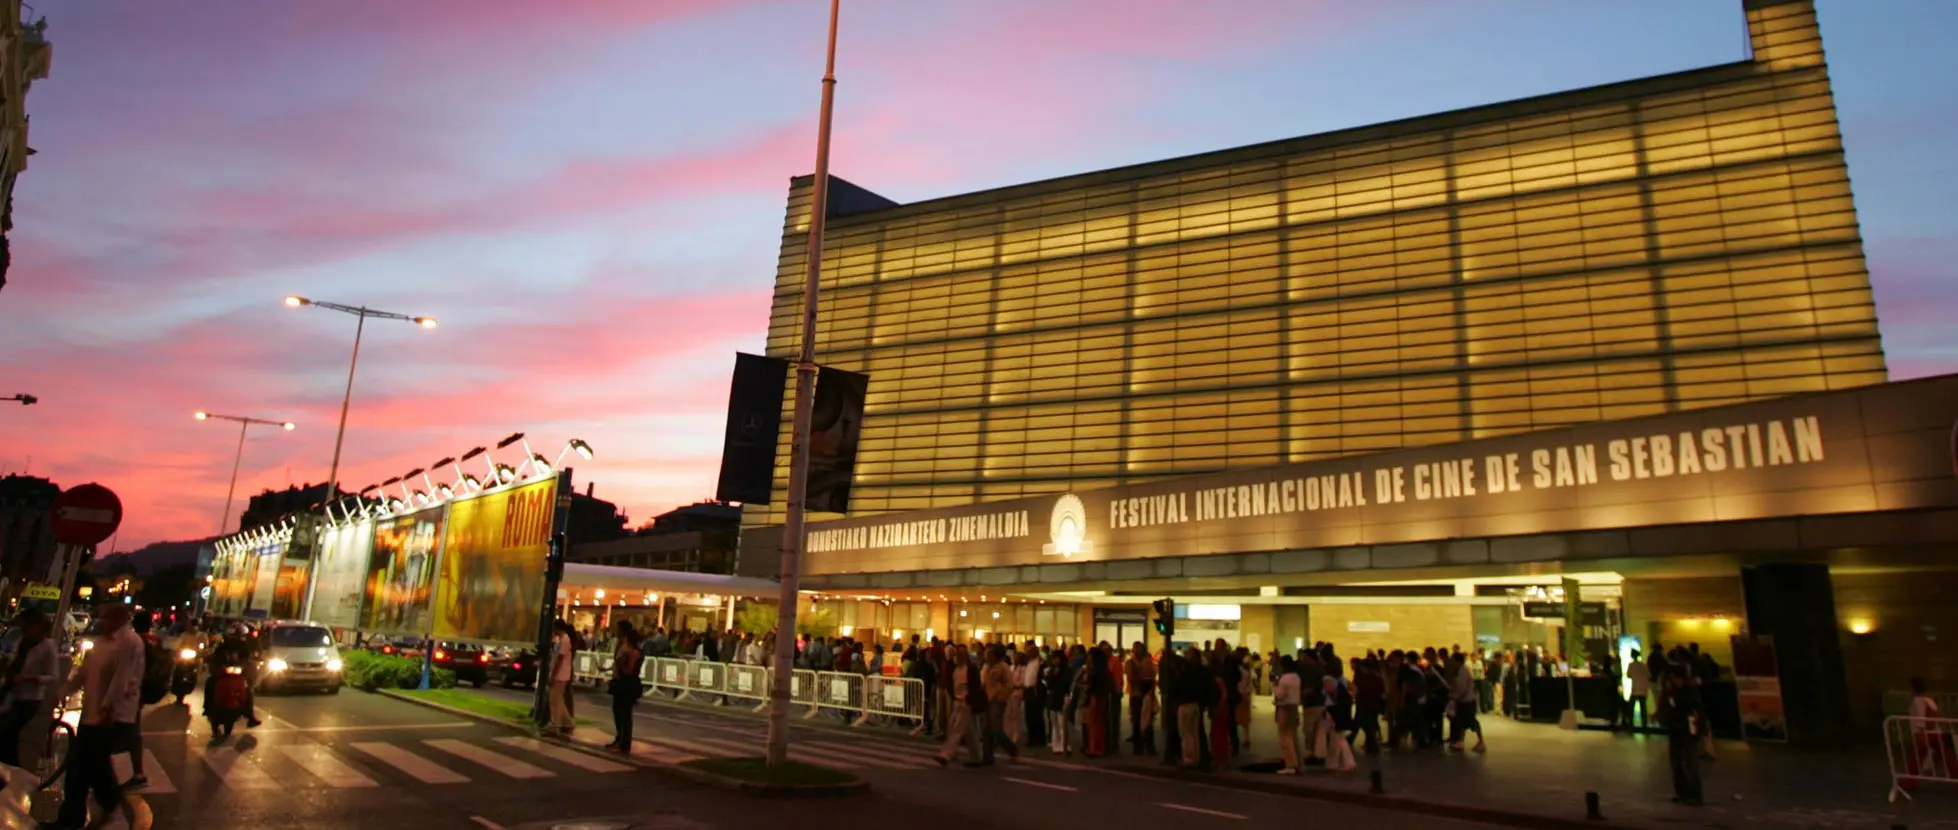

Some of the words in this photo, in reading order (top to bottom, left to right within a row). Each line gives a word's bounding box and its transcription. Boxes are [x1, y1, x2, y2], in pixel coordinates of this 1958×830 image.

[1110, 492, 1188, 529] FESTIVAL
[1196, 472, 1366, 521] INTERNACIONAL
[1375, 467, 1405, 504] DE
[1414, 458, 1476, 500] CINE
[1485, 453, 1522, 494] DE
[1532, 444, 1597, 488] SAN
[1608, 416, 1824, 481] SEBASTIAN
[502, 485, 555, 549] ROMA
[807, 526, 867, 553] DONOSTIAKO
[869, 518, 946, 549] NAZIOARTEKO
[949, 509, 1029, 543] ZINEMALDIA
